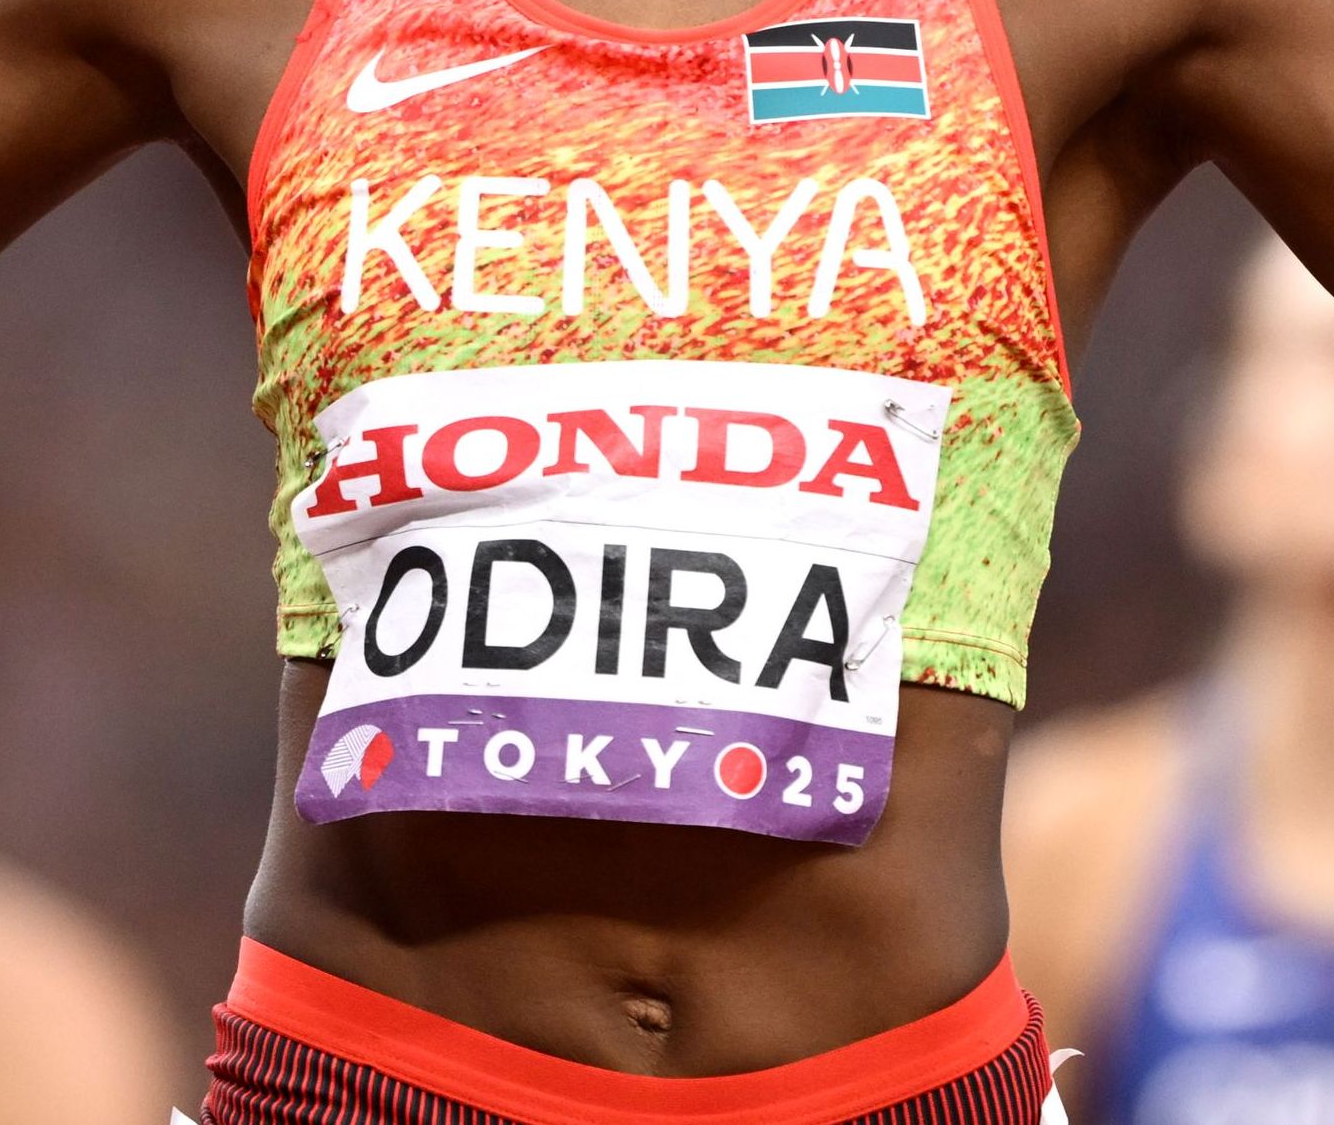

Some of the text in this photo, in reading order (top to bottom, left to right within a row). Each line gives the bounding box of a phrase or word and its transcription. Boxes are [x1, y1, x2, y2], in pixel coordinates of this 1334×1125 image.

[340, 177, 926, 327] KENYA
[307, 405, 921, 519] HONDA
[364, 539, 850, 703] ODIRA
